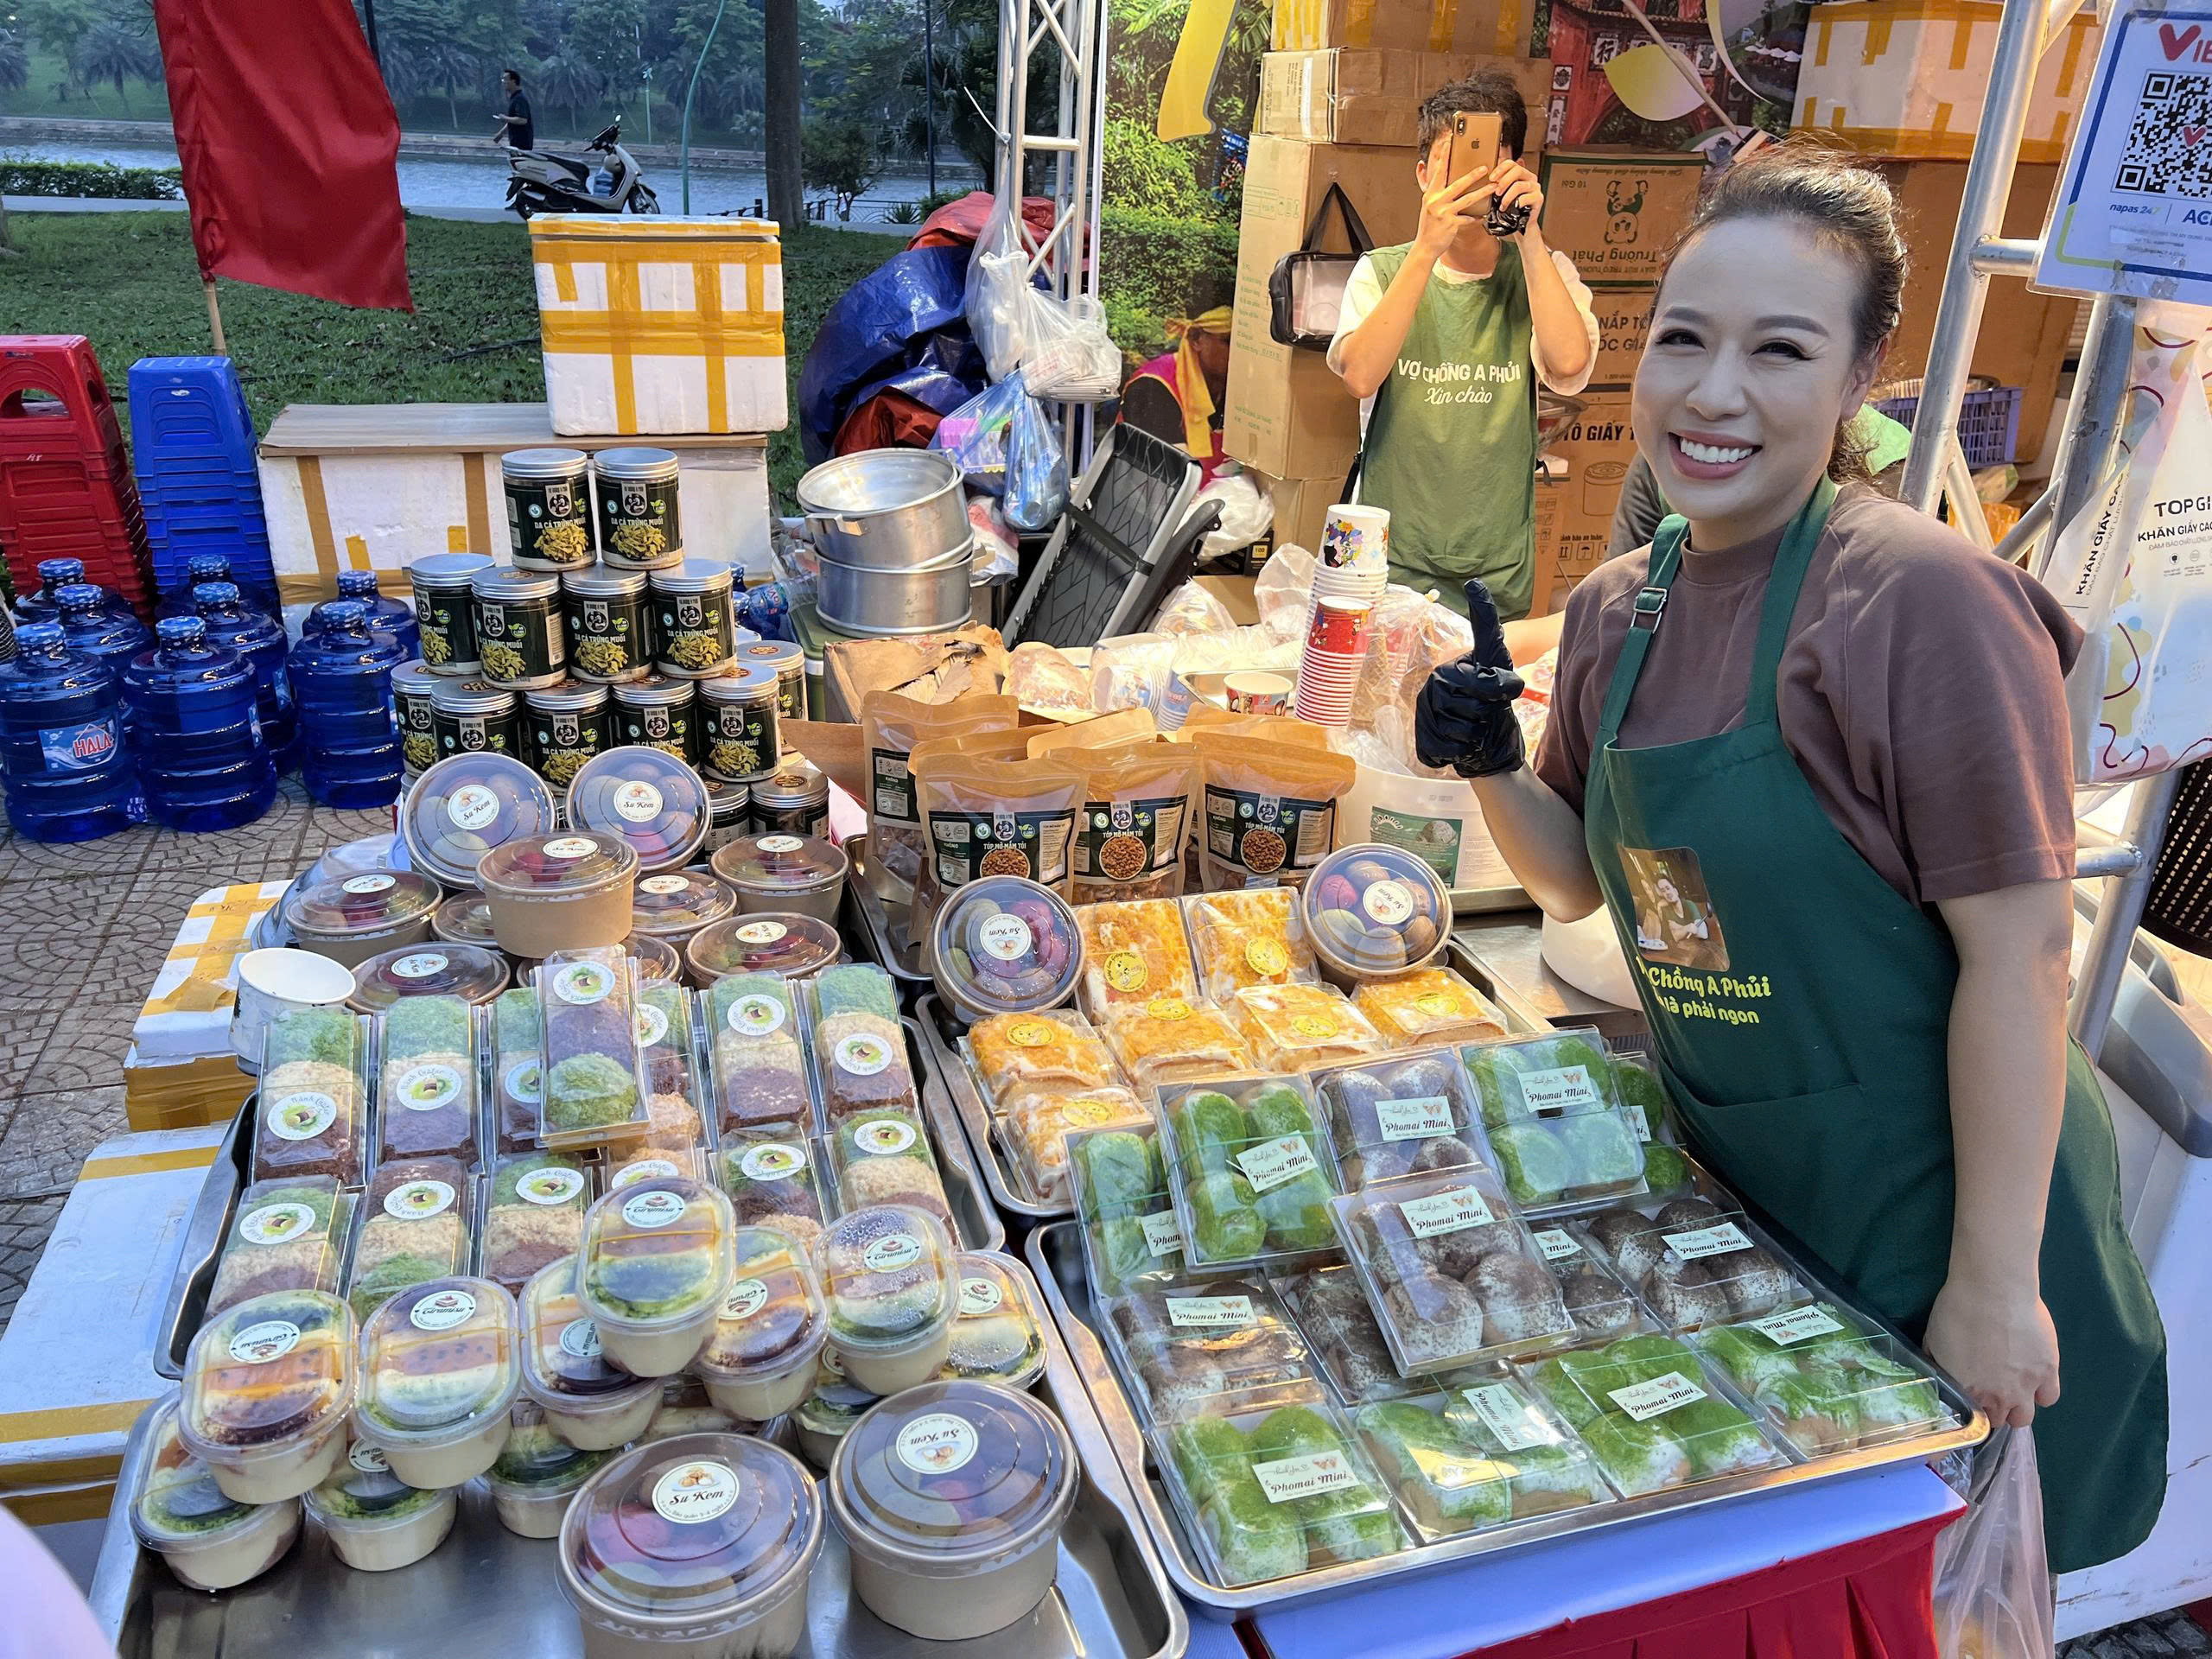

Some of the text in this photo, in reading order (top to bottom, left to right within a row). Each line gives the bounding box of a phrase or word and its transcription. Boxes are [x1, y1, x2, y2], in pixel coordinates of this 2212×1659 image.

[2109, 204, 2160, 215] napas 247
[2182, 209, 2212, 226] AC
[1572, 248, 1657, 264] Trường Phát
[1599, 310, 1628, 329] NẮP
[1599, 333, 1618, 351] ỐC
[1397, 359, 1522, 384] VỢ CHỒNG A PHỦI
[1424, 385, 1493, 404] Xin chào
[1586, 420, 1624, 441] GIẤY
[2138, 519, 2198, 542] KHĂN GIẤY
[2075, 510, 2112, 595] KHĂN GIẤY
[463, 800, 491, 821] Su Kem
[636, 800, 655, 810] Kem
[1649, 966, 1772, 998] Chồng A Phủi
[1682, 1001, 1716, 1019] phải
[1719, 1008, 1759, 1025] ngon
[1529, 1087, 1586, 1103] Phomai Mini
[1386, 1119, 1446, 1133] Phomai Mini
[1253, 1154, 1308, 1183] Phomai Mini
[1416, 1216, 1454, 1231] Phomai
[1457, 1209, 1482, 1222] Mini
[1154, 1233, 1180, 1248] Phom
[1547, 1242, 1571, 1253] Mini
[1680, 1237, 1742, 1254] Phomai Mini
[874, 1249, 912, 1261] Tiramisu
[1220, 1312, 1247, 1320] Mini
[1763, 1312, 1819, 1332] Phomai Mini
[240, 1333, 288, 1348] Tiramisu
[1631, 1387, 1694, 1414] Phomai Mini
[1473, 1390, 1518, 1446] Phomai Mini
[910, 1429, 960, 1446] Su Kem
[1271, 1477, 1315, 1493] Phomai
[1318, 1471, 1348, 1484] Mini
[669, 1490, 724, 1505] Su Kem
